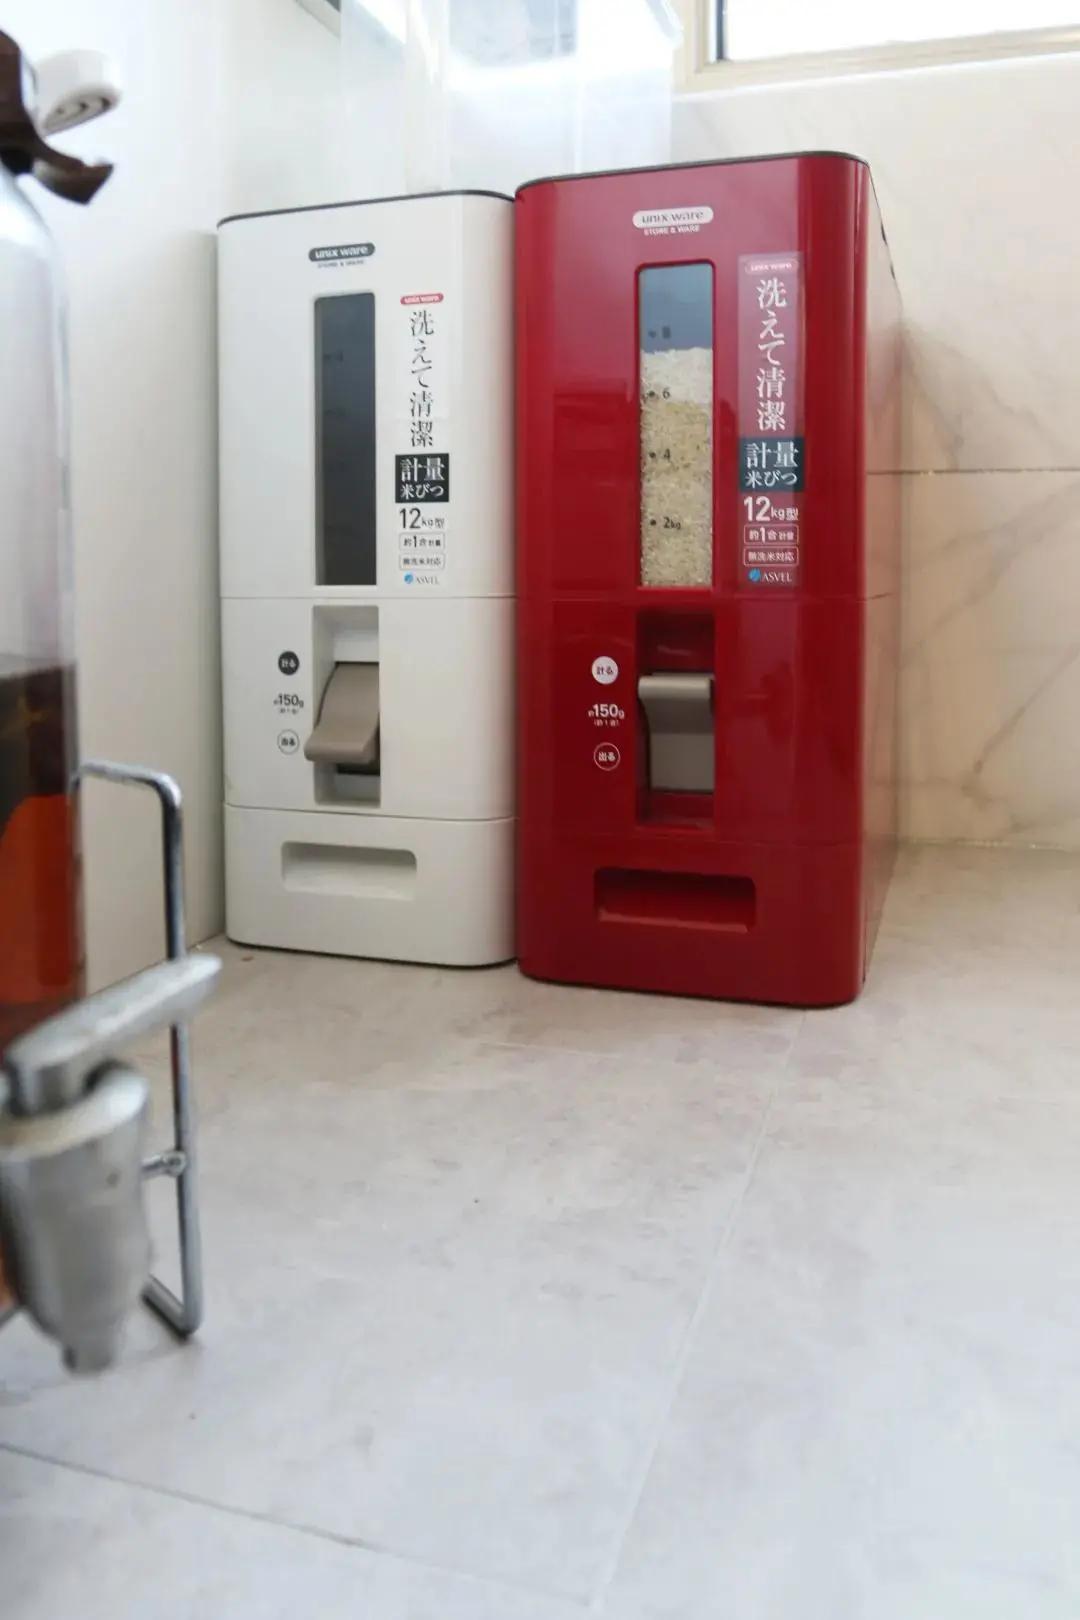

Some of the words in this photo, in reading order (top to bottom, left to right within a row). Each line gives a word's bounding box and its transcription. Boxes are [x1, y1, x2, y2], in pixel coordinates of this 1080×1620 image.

[642, 213, 668, 224] unix
[671, 210, 704, 222] ware
[314, 248, 339, 260] unix
[340, 245, 369, 257] ware
[756, 277, 787, 432] 洗えて清潔
[410, 309, 434, 448] 洗えて清潔
[662, 387, 670, 399] 6
[664, 448, 671, 460] 4
[745, 441, 799, 469] 計量
[401, 457, 445, 482] 計量
[745, 470, 798, 489] 米びつ
[401, 482, 445, 500] 米びつ
[743, 495, 799, 522] 12kg型
[762, 571, 793, 583] ASVEL
